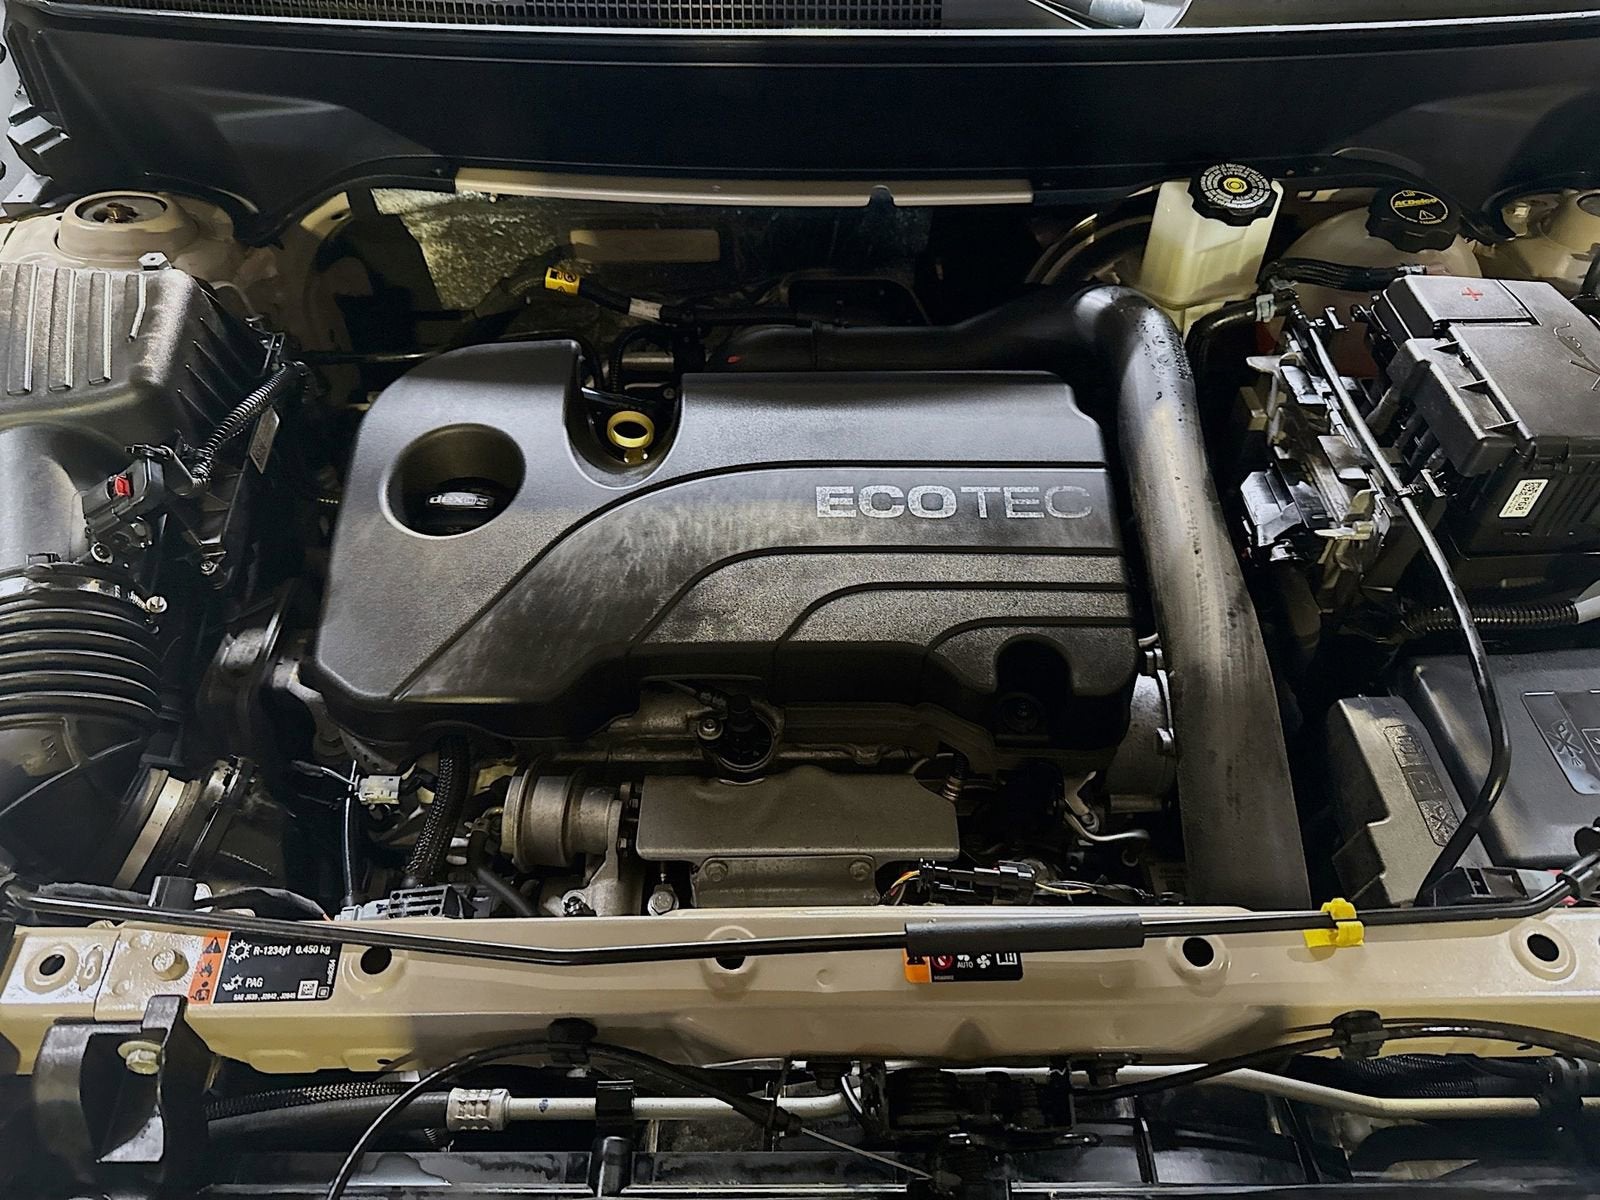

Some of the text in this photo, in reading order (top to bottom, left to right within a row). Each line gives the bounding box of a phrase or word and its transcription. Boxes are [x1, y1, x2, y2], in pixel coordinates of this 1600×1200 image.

[815, 485, 1092, 519] ECOTEC
[253, 945, 331, 957] R-1234yf 0.450 kg
[957, 961, 974, 969] AUTO
[245, 977, 264, 988] PAG
